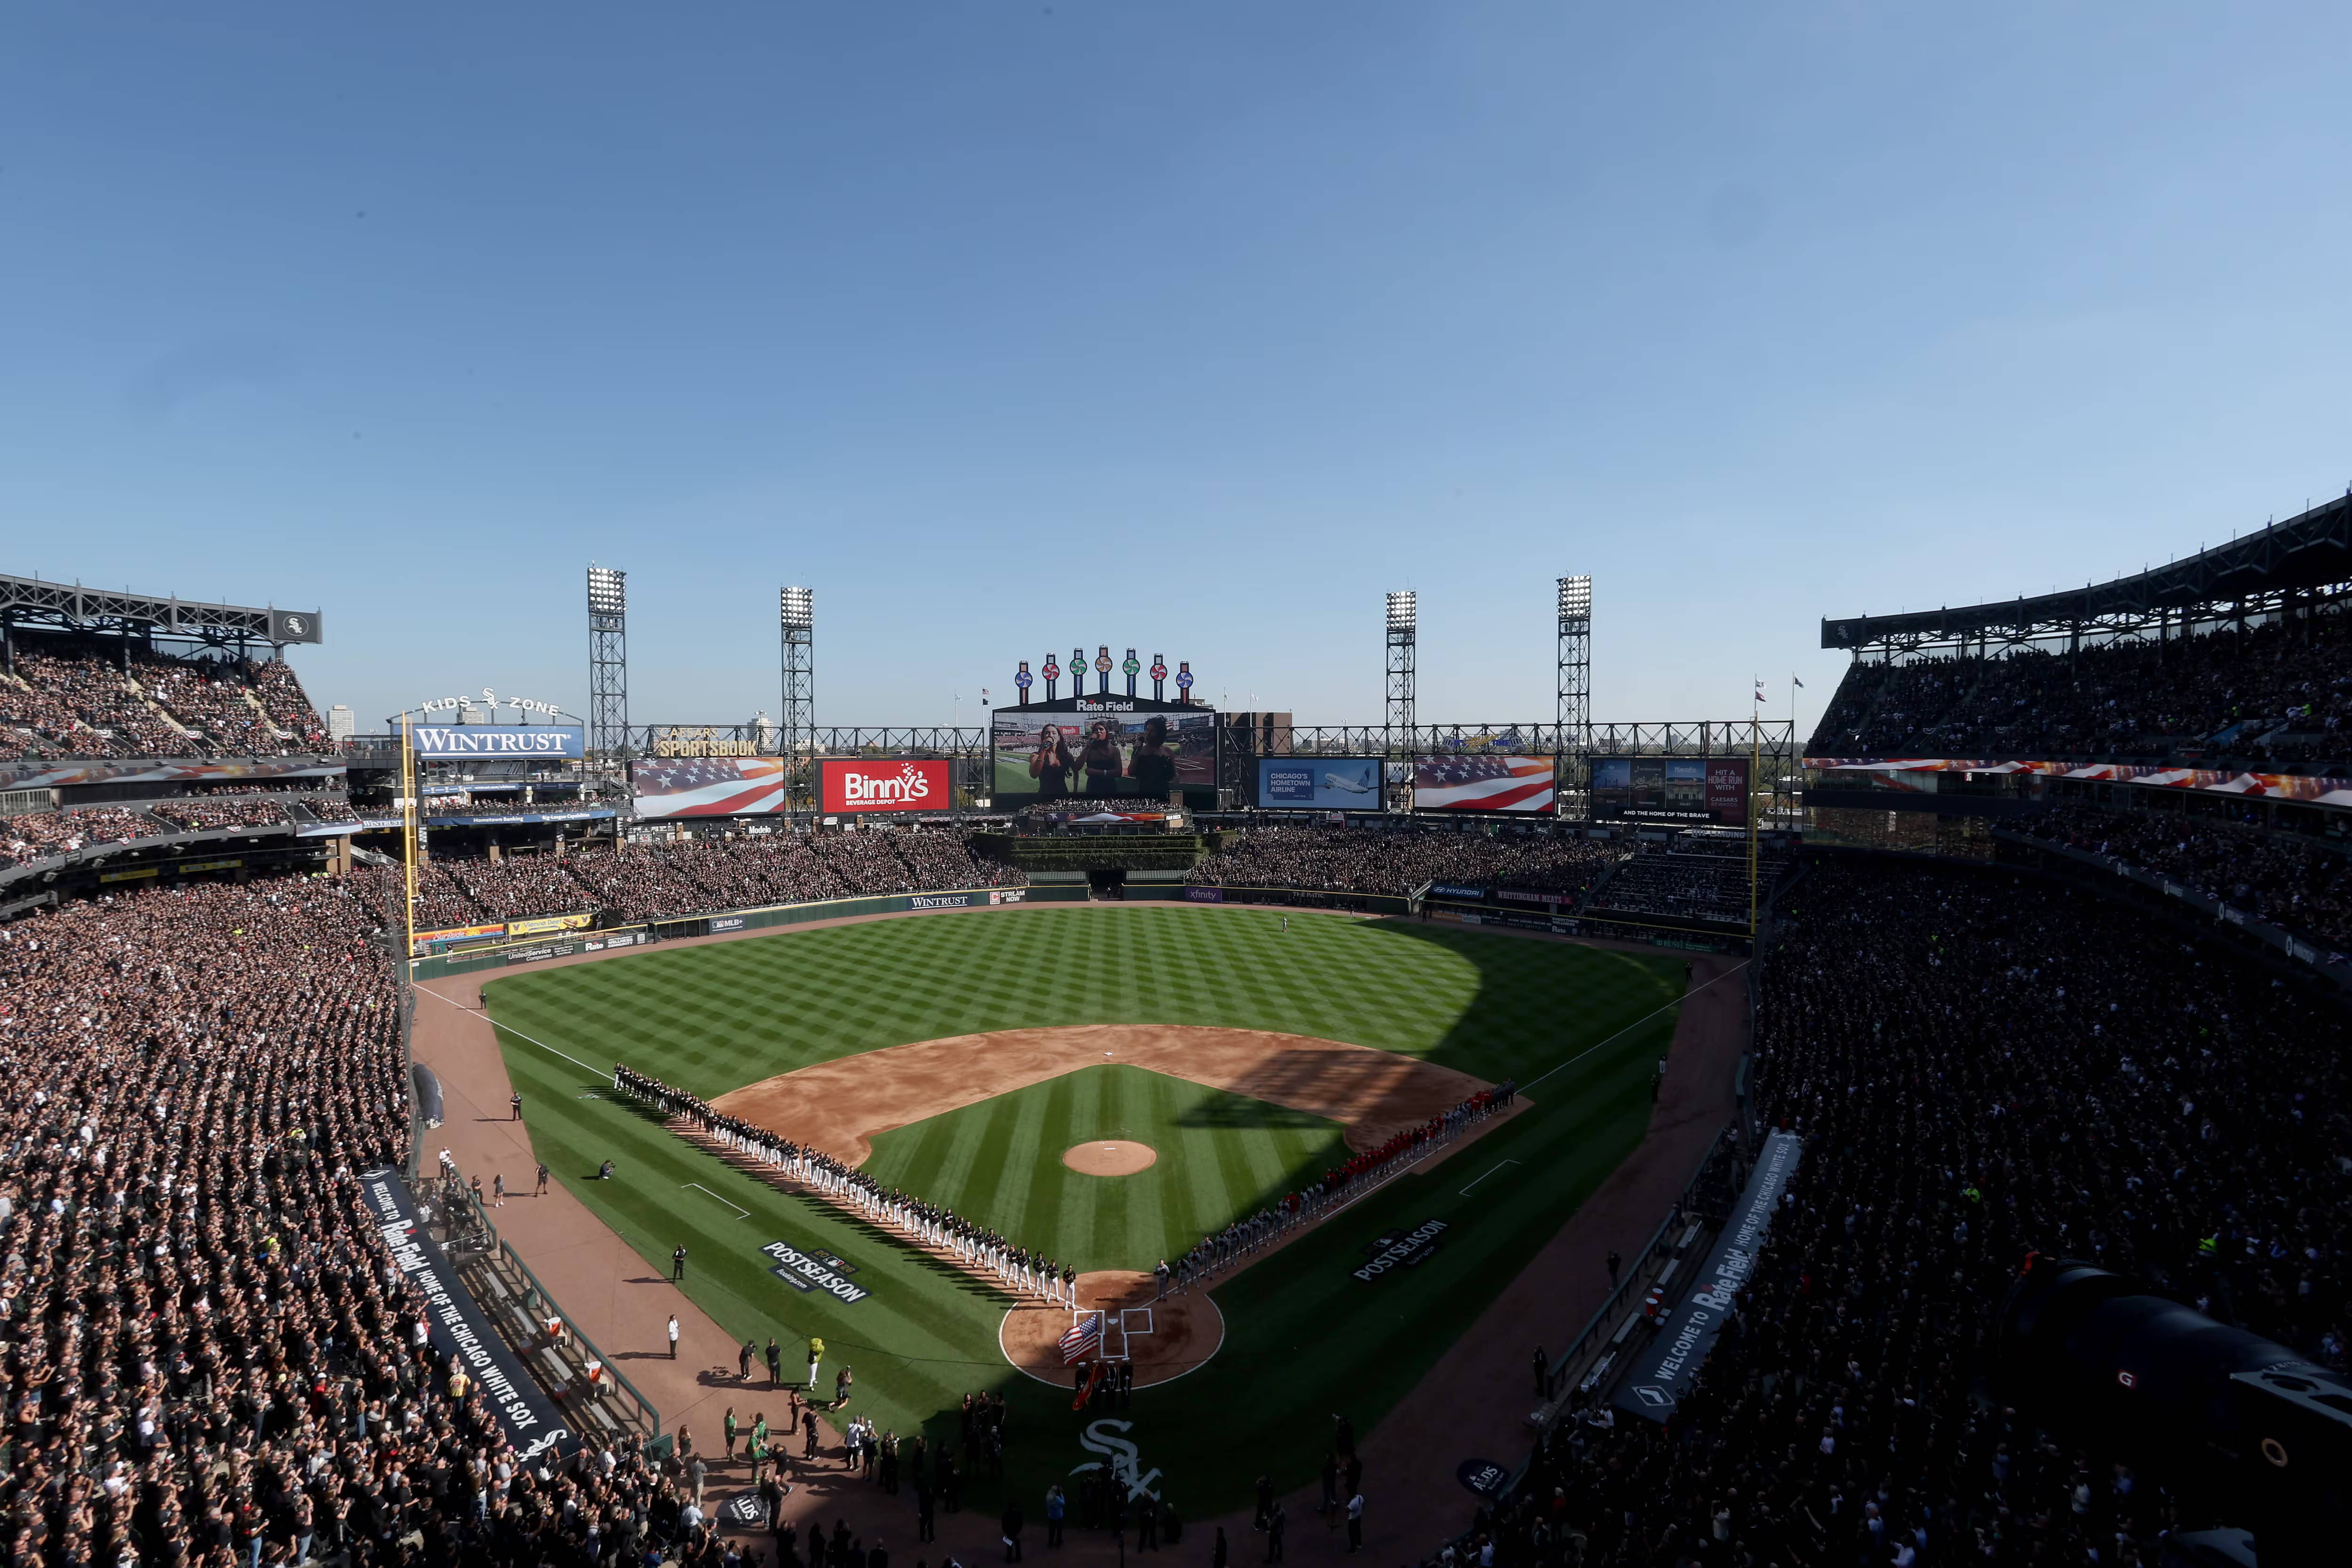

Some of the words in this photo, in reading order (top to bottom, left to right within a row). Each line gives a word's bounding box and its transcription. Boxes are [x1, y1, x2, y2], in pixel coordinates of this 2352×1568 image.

[422, 695, 471, 713] KIDS
[509, 696, 560, 716] ZONE
[1076, 699, 1104, 711] Rate
[1105, 701, 1133, 711] Field
[660, 727, 718, 738] CAESARS
[660, 740, 757, 757] SPORTSBOOK
[1728, 776, 1742, 784] RUN
[749, 826, 771, 834] Modelo
[912, 896, 968, 907] WINTRUST
[1191, 890, 1216, 900] xfinity
[1498, 891, 1539, 902] WHITTINGHAM
[1542, 895, 1562, 904] MEATS
[433, 931, 465, 941] Surfside
[1552, 925, 1566, 934] Rate
[585, 941, 604, 951] Rate
[1776, 1143, 1791, 1156] SOX
[1768, 1154, 1786, 1175] WHITE
[1757, 1173, 1779, 1202] CHICAGO
[371, 1181, 397, 1212] WELCOME
[385, 1209, 401, 1220] TO
[1749, 1200, 1768, 1214] THE
[1745, 1214, 1760, 1227] OF
[381, 1218, 415, 1248] Rate
[1734, 1225, 1756, 1247] HOME
[391, 1242, 431, 1273] Field
[1353, 1220, 1448, 1281] POSTSEASON
[763, 1242, 866, 1302] POSTSEASON
[777, 1268, 808, 1289] Booking.com
[416, 1269, 444, 1295] HOME
[430, 1292, 452, 1306] OF
[1692, 1278, 1738, 1311] Rate
[438, 1302, 463, 1326] THE
[1689, 1311, 1709, 1326] TO
[450, 1323, 493, 1368] CHICAGO
[1654, 1325, 1701, 1381] WELCOME
[479, 1365, 519, 1404] WHITE
[2119, 1372, 2134, 1386] G
[505, 1401, 538, 1430] SOX
